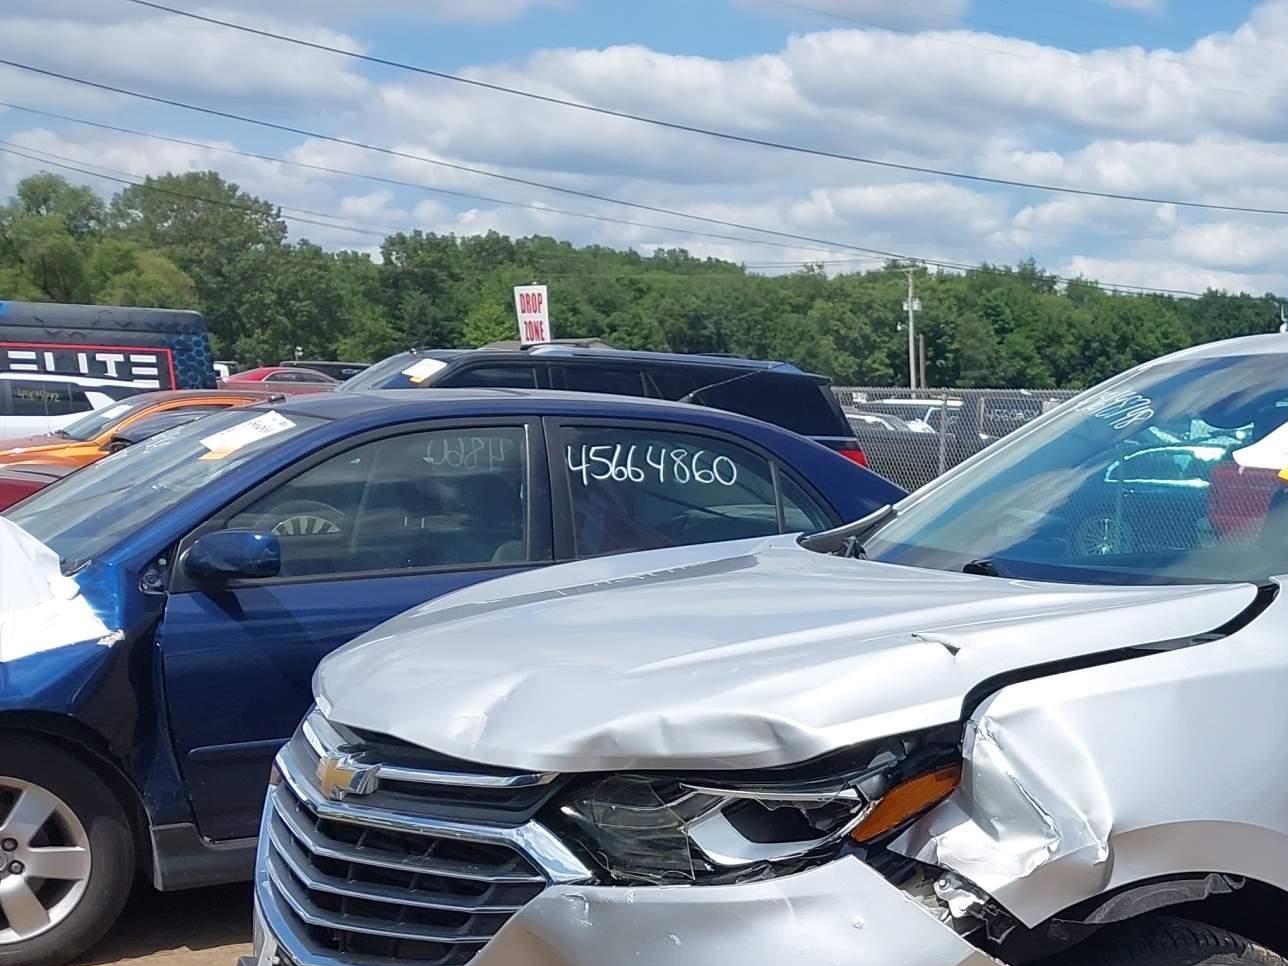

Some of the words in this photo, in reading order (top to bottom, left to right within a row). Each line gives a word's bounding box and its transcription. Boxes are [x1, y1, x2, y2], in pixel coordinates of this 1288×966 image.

[519, 292, 543, 314] DROP
[523, 320, 545, 342] ZONE
[567, 444, 737, 486] 45664860
